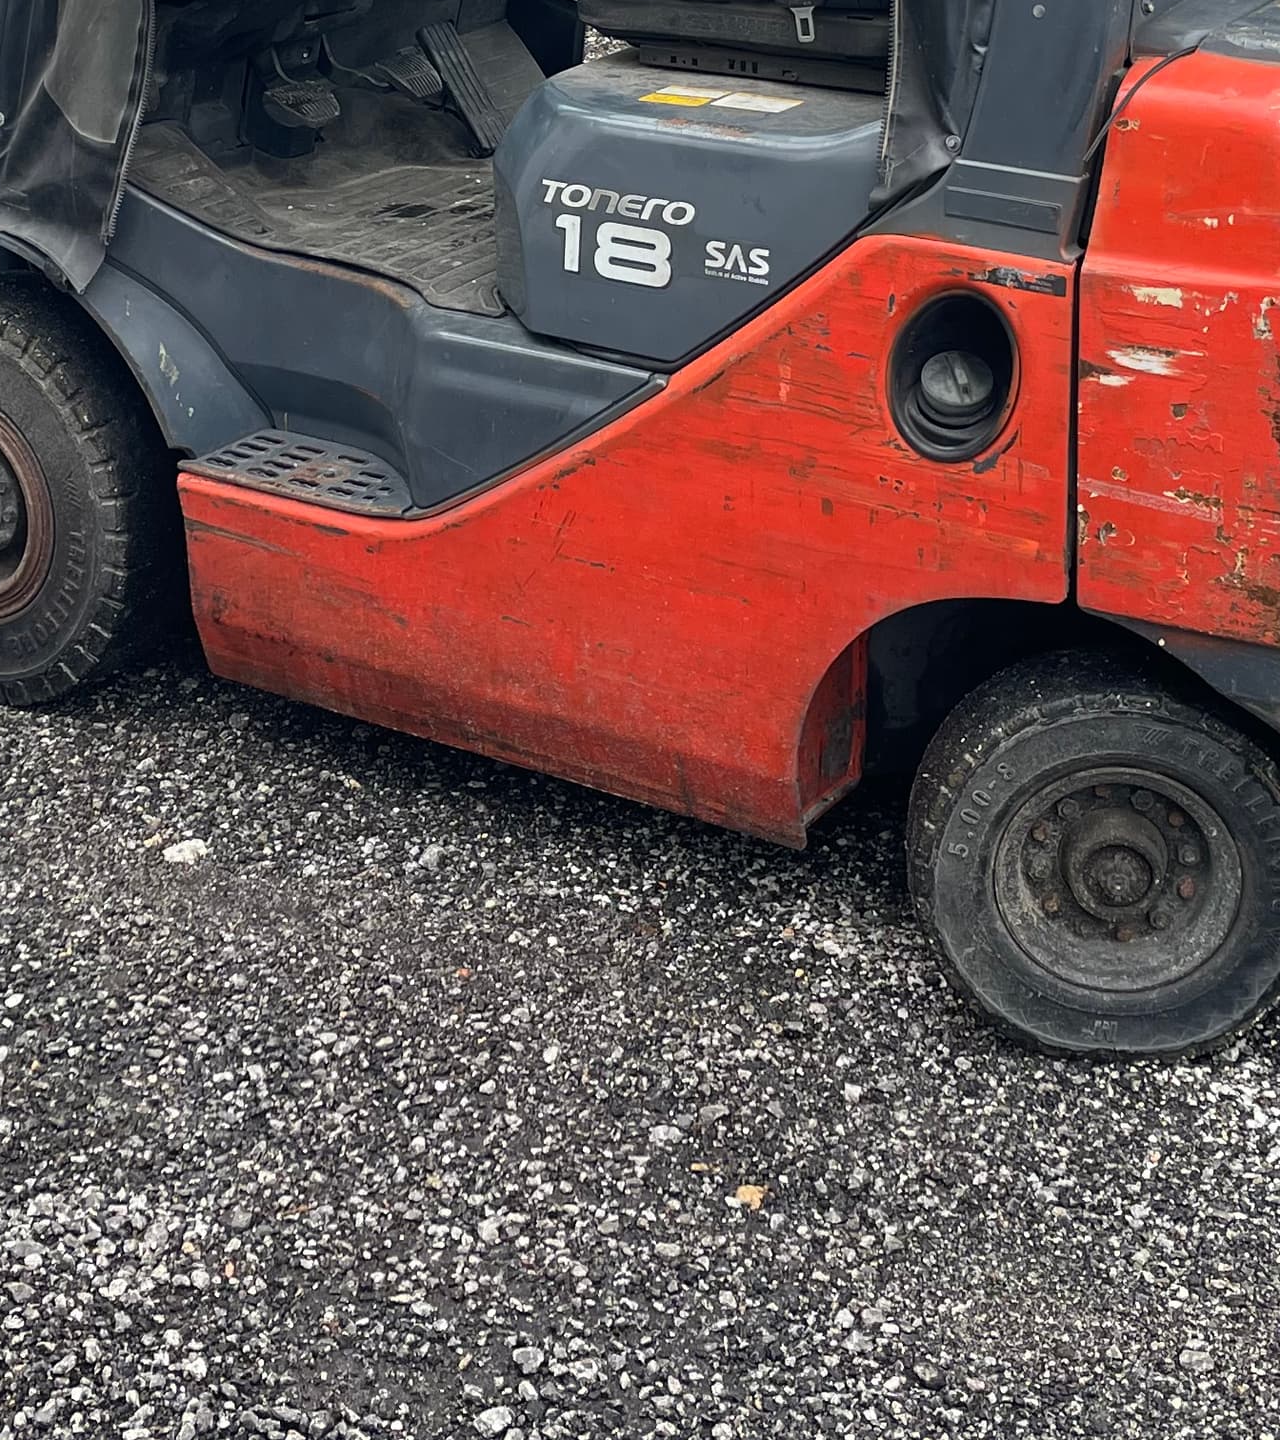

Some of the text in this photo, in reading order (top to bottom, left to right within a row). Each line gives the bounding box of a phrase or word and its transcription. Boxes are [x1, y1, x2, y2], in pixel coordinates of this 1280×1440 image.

[555, 214, 672, 288] 18
[705, 240, 770, 275] SAS
[946, 761, 1017, 858] 5.00-8
